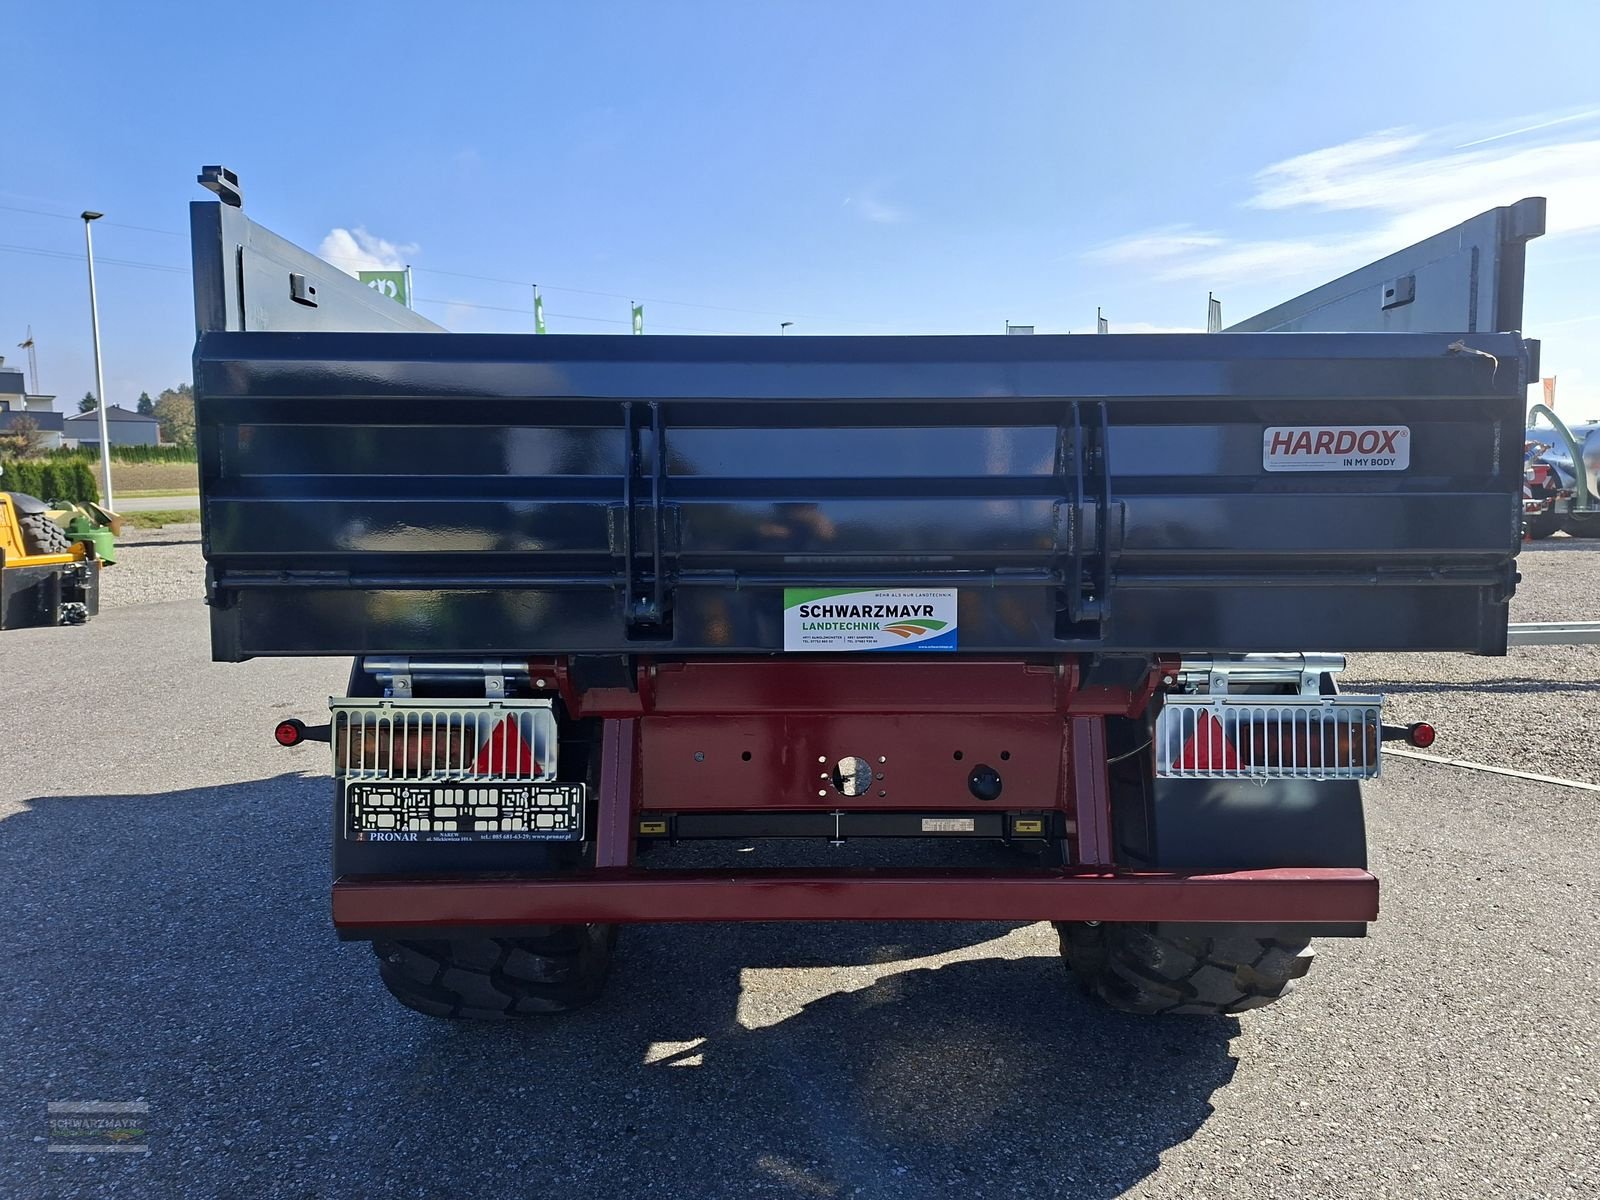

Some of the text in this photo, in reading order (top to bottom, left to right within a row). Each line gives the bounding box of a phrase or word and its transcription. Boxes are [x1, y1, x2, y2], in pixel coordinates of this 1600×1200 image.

[1343, 458, 1396, 466] IN MY BODY
[799, 604, 934, 618] SCHWARZMAYR
[802, 622, 881, 631] LANDTECHNIK
[370, 832, 418, 842] PRONAR
